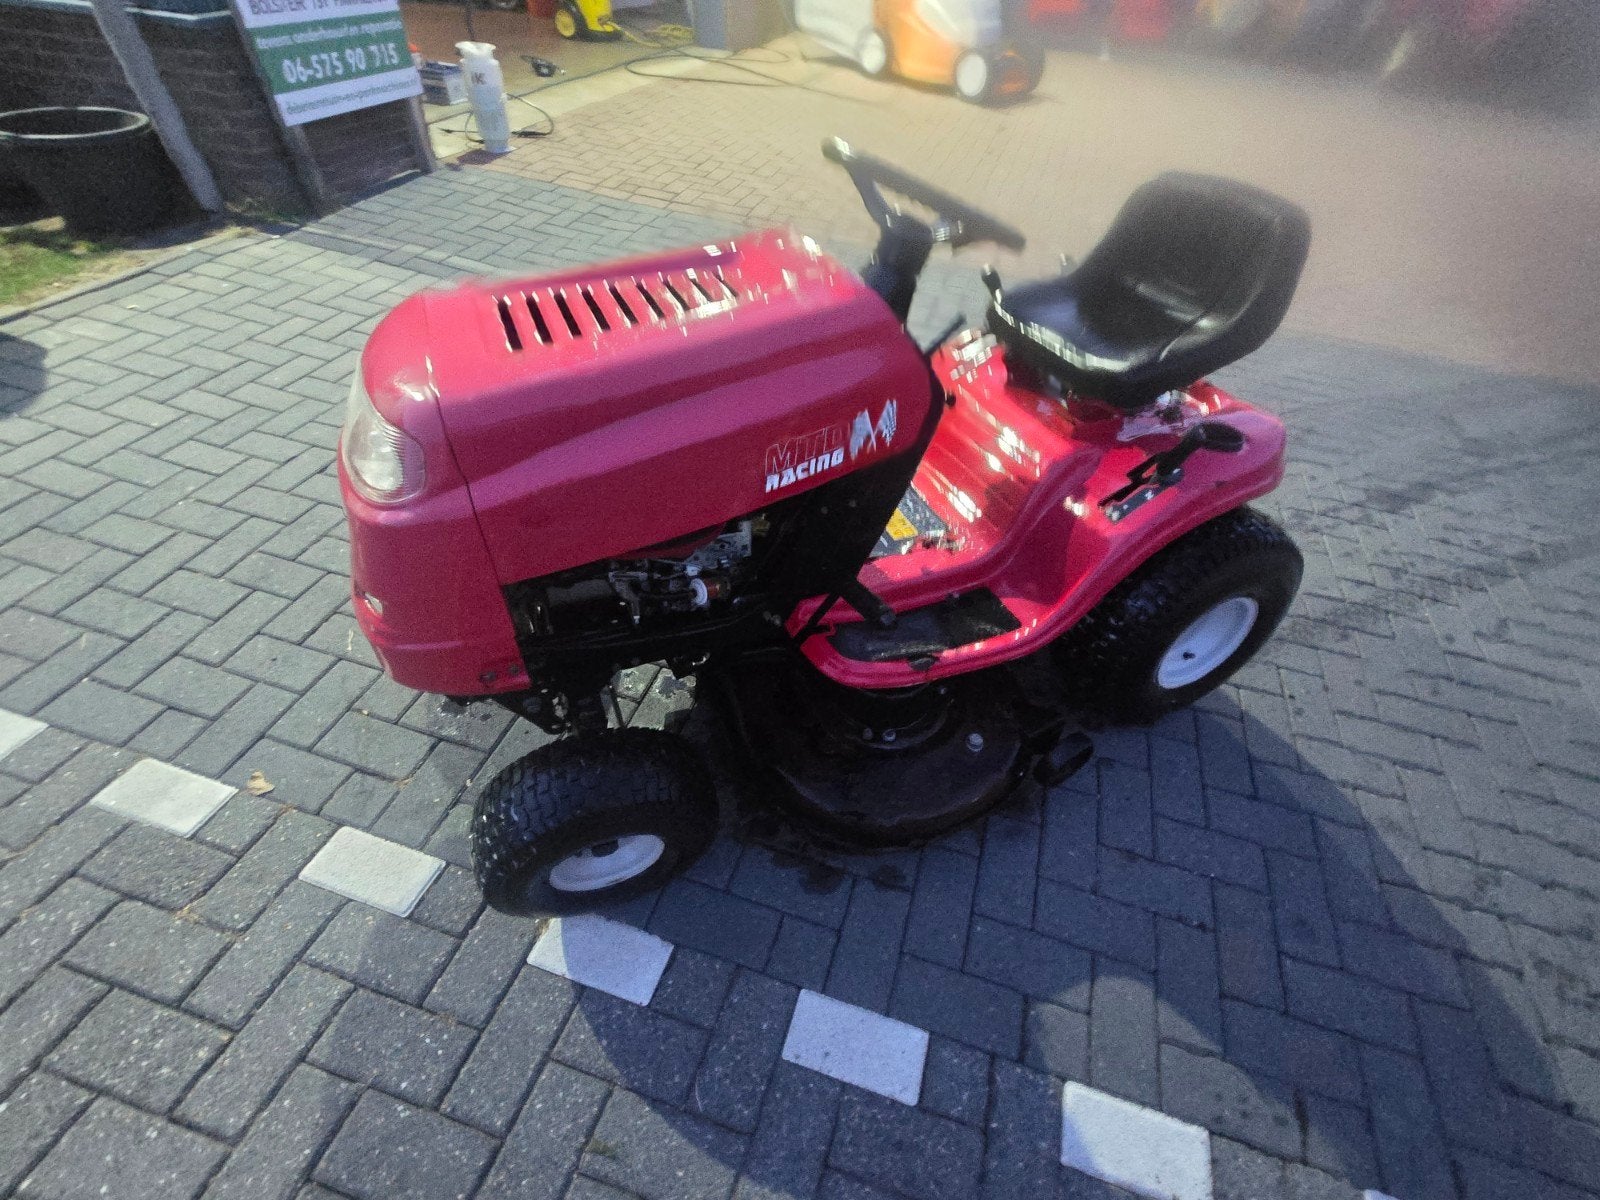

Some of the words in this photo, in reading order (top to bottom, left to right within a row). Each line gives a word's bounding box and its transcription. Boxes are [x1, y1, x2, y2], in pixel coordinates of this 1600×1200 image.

[282, 56, 343, 84] 06-575
[345, 47, 366, 73] 90
[368, 42, 399, 69] 715
[765, 420, 850, 475] MTD
[766, 447, 844, 493] RACING
